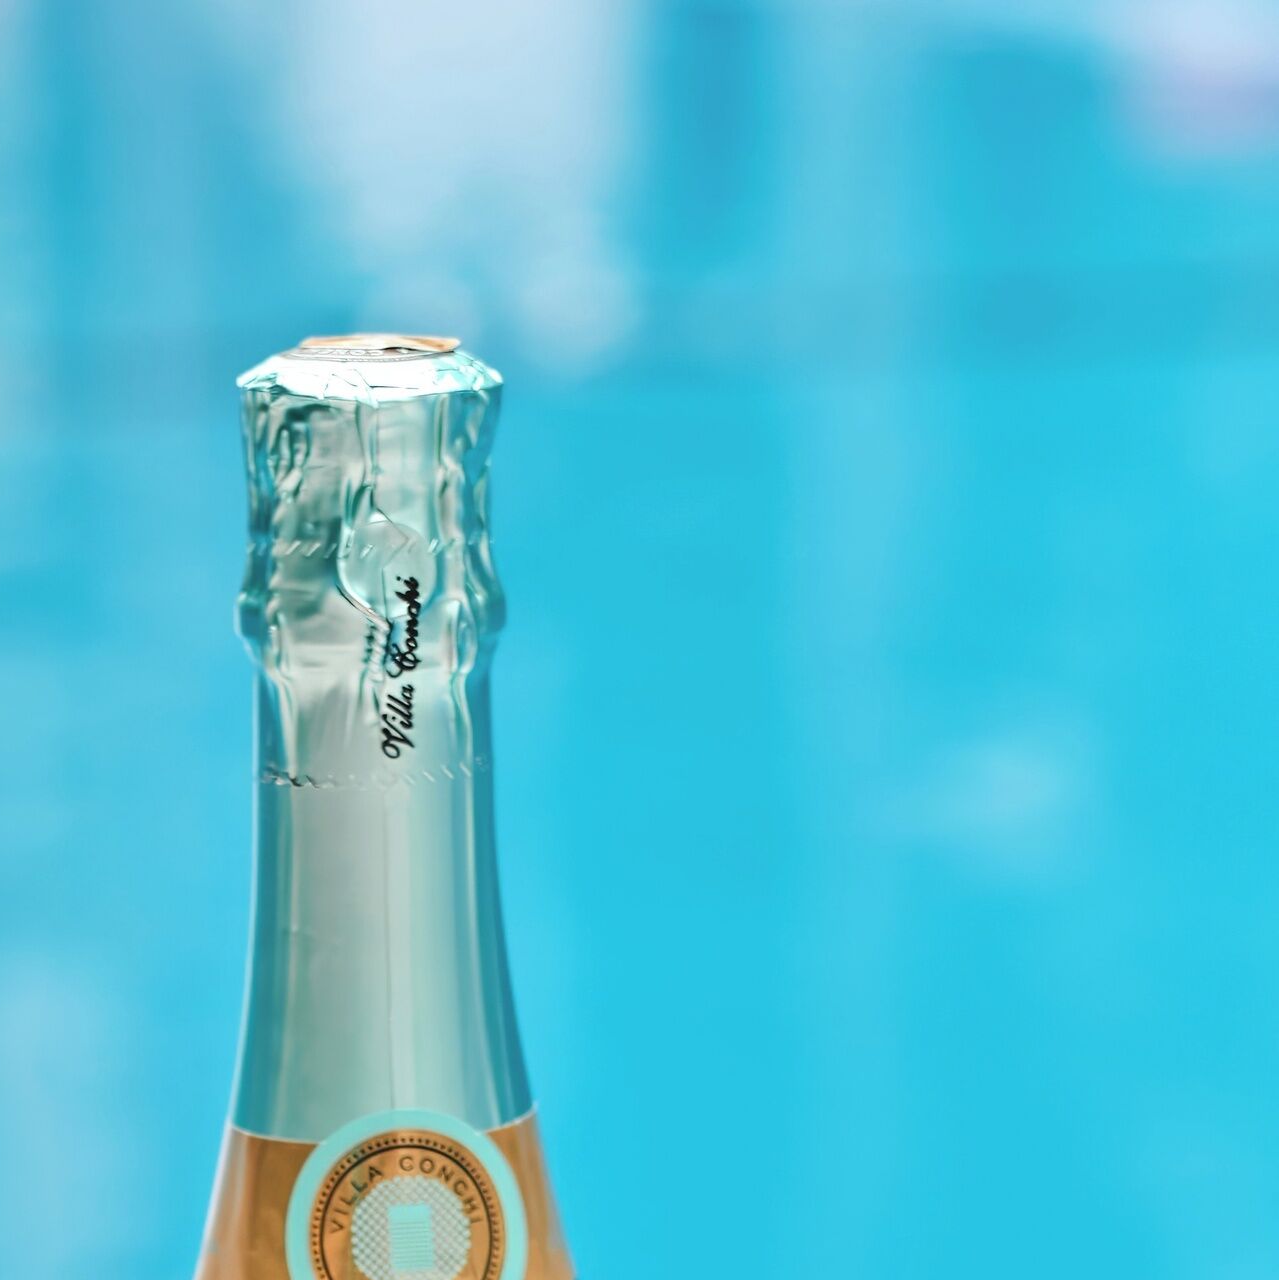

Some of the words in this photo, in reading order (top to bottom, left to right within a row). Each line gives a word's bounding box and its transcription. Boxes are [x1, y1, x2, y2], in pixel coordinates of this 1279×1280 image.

[387, 576, 422, 679] Conchi
[382, 684, 415, 759] Villa
[330, 1164, 383, 1234] VILLA
[399, 1155, 483, 1226] CONCHI
